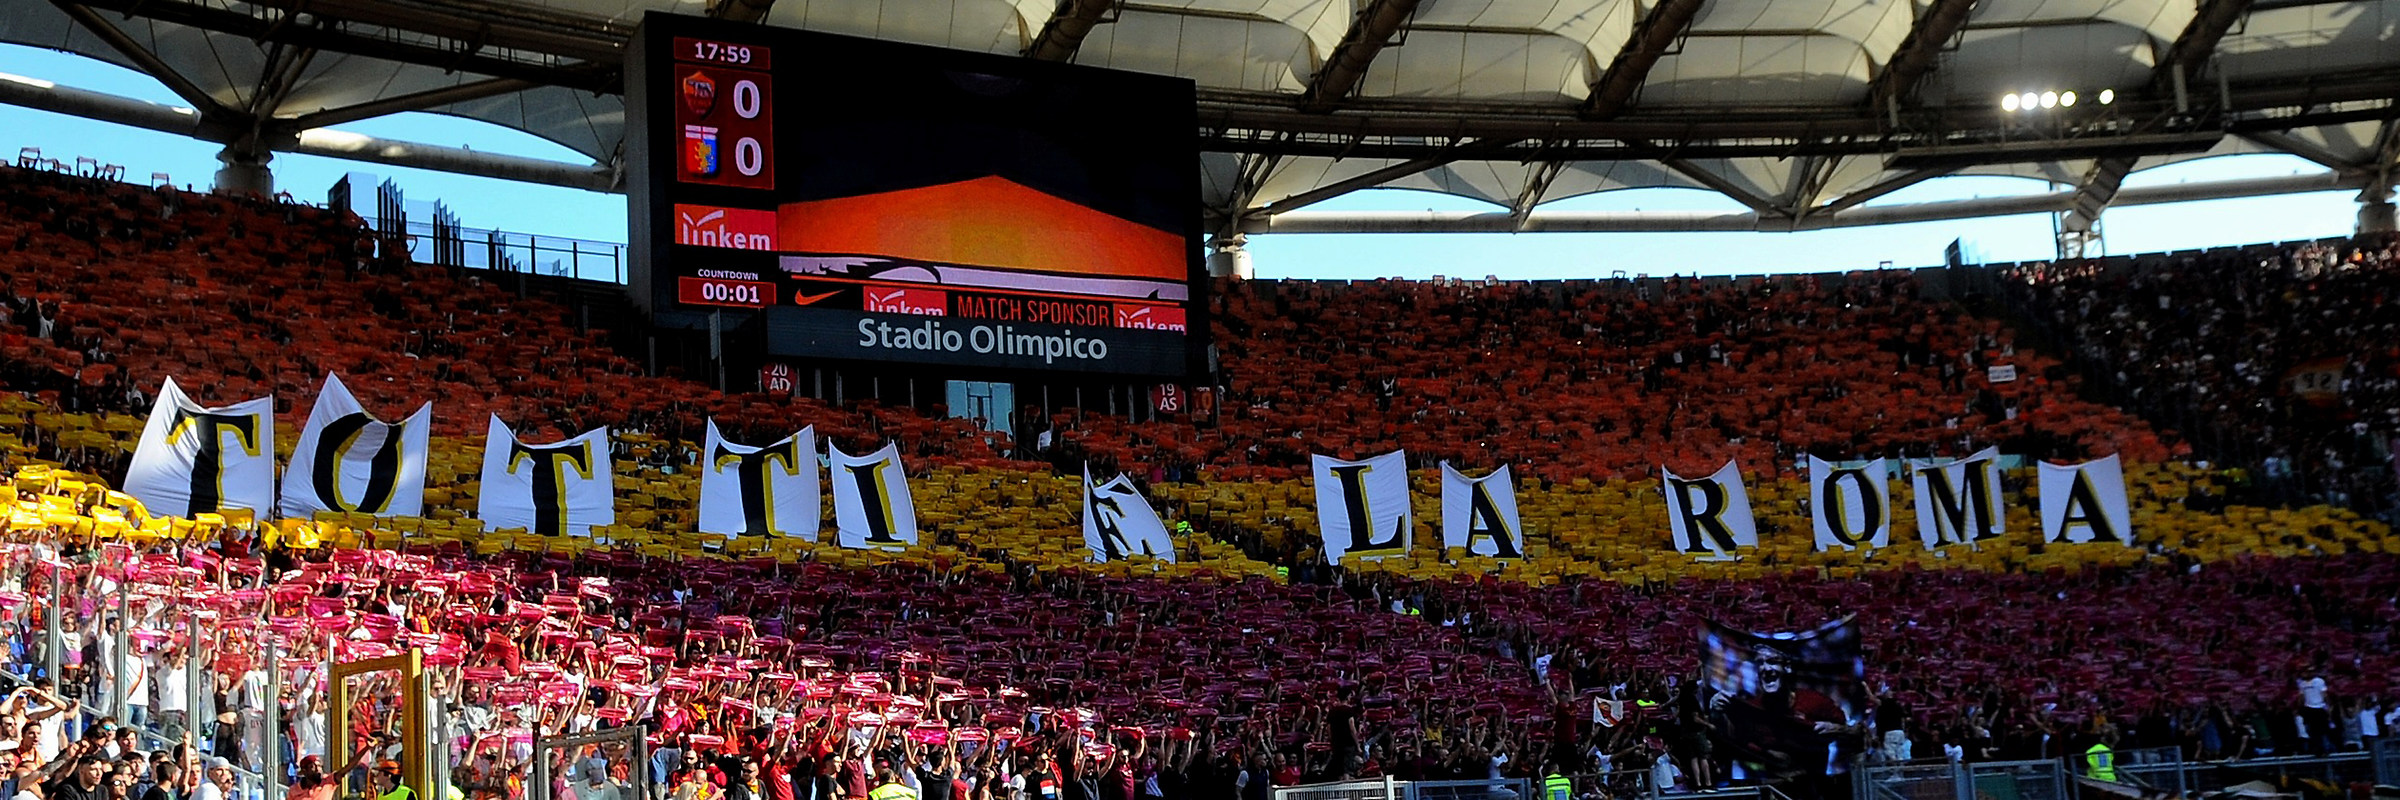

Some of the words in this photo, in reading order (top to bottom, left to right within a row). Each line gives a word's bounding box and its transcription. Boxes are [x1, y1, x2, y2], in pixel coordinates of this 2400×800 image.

[694, 41, 751, 64] 17:59
[733, 79, 760, 119] 0
[735, 136, 763, 176] 0
[682, 209, 771, 252] linkem
[697, 268, 759, 281] COUNTDOWN
[702, 281, 760, 304] 00:01
[957, 295, 1022, 321] MATCH
[1027, 300, 1110, 328] SPONSOR
[858, 317, 963, 352] Stadio
[969, 324, 1108, 364] Olimpico
[771, 363, 788, 377] 20
[1159, 397, 1177, 411] AS
[1160, 383, 1175, 397] 19
[166, 405, 908, 546] TOTTI
[1330, 464, 1522, 558] LA
[1667, 457, 2122, 553] ROMA
